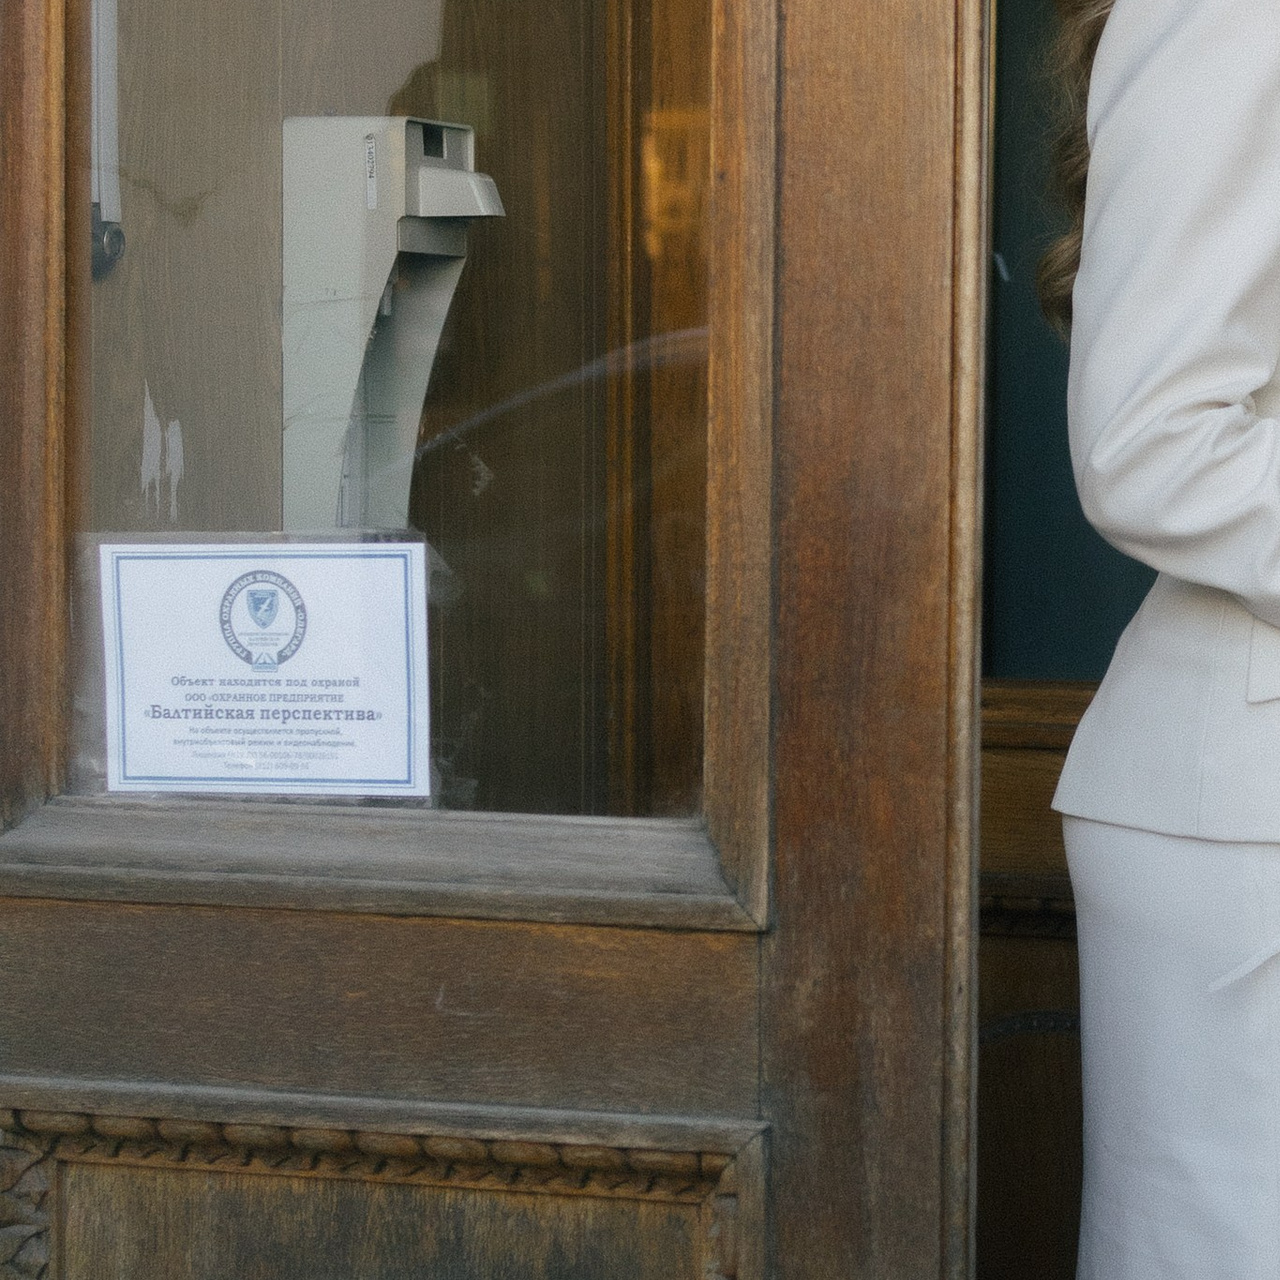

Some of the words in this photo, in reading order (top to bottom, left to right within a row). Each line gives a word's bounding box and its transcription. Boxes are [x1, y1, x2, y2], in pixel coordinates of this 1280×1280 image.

[222, 575, 255, 621] ОХРАННЫХ
[255, 573, 301, 606] КОМПАНИЙ
[222, 623, 249, 658] ГРУППА
[171, 676, 214, 687] Объект
[219, 678, 281, 688] находится
[286, 679, 307, 688] под
[311, 676, 360, 689] охраной
[184, 693, 206, 702] ООО
[269, 693, 344, 703] ПРЕДПРИЯТИЕ
[145, 704, 255, 720] «Балтийская
[260, 708, 382, 725] перспектива»
